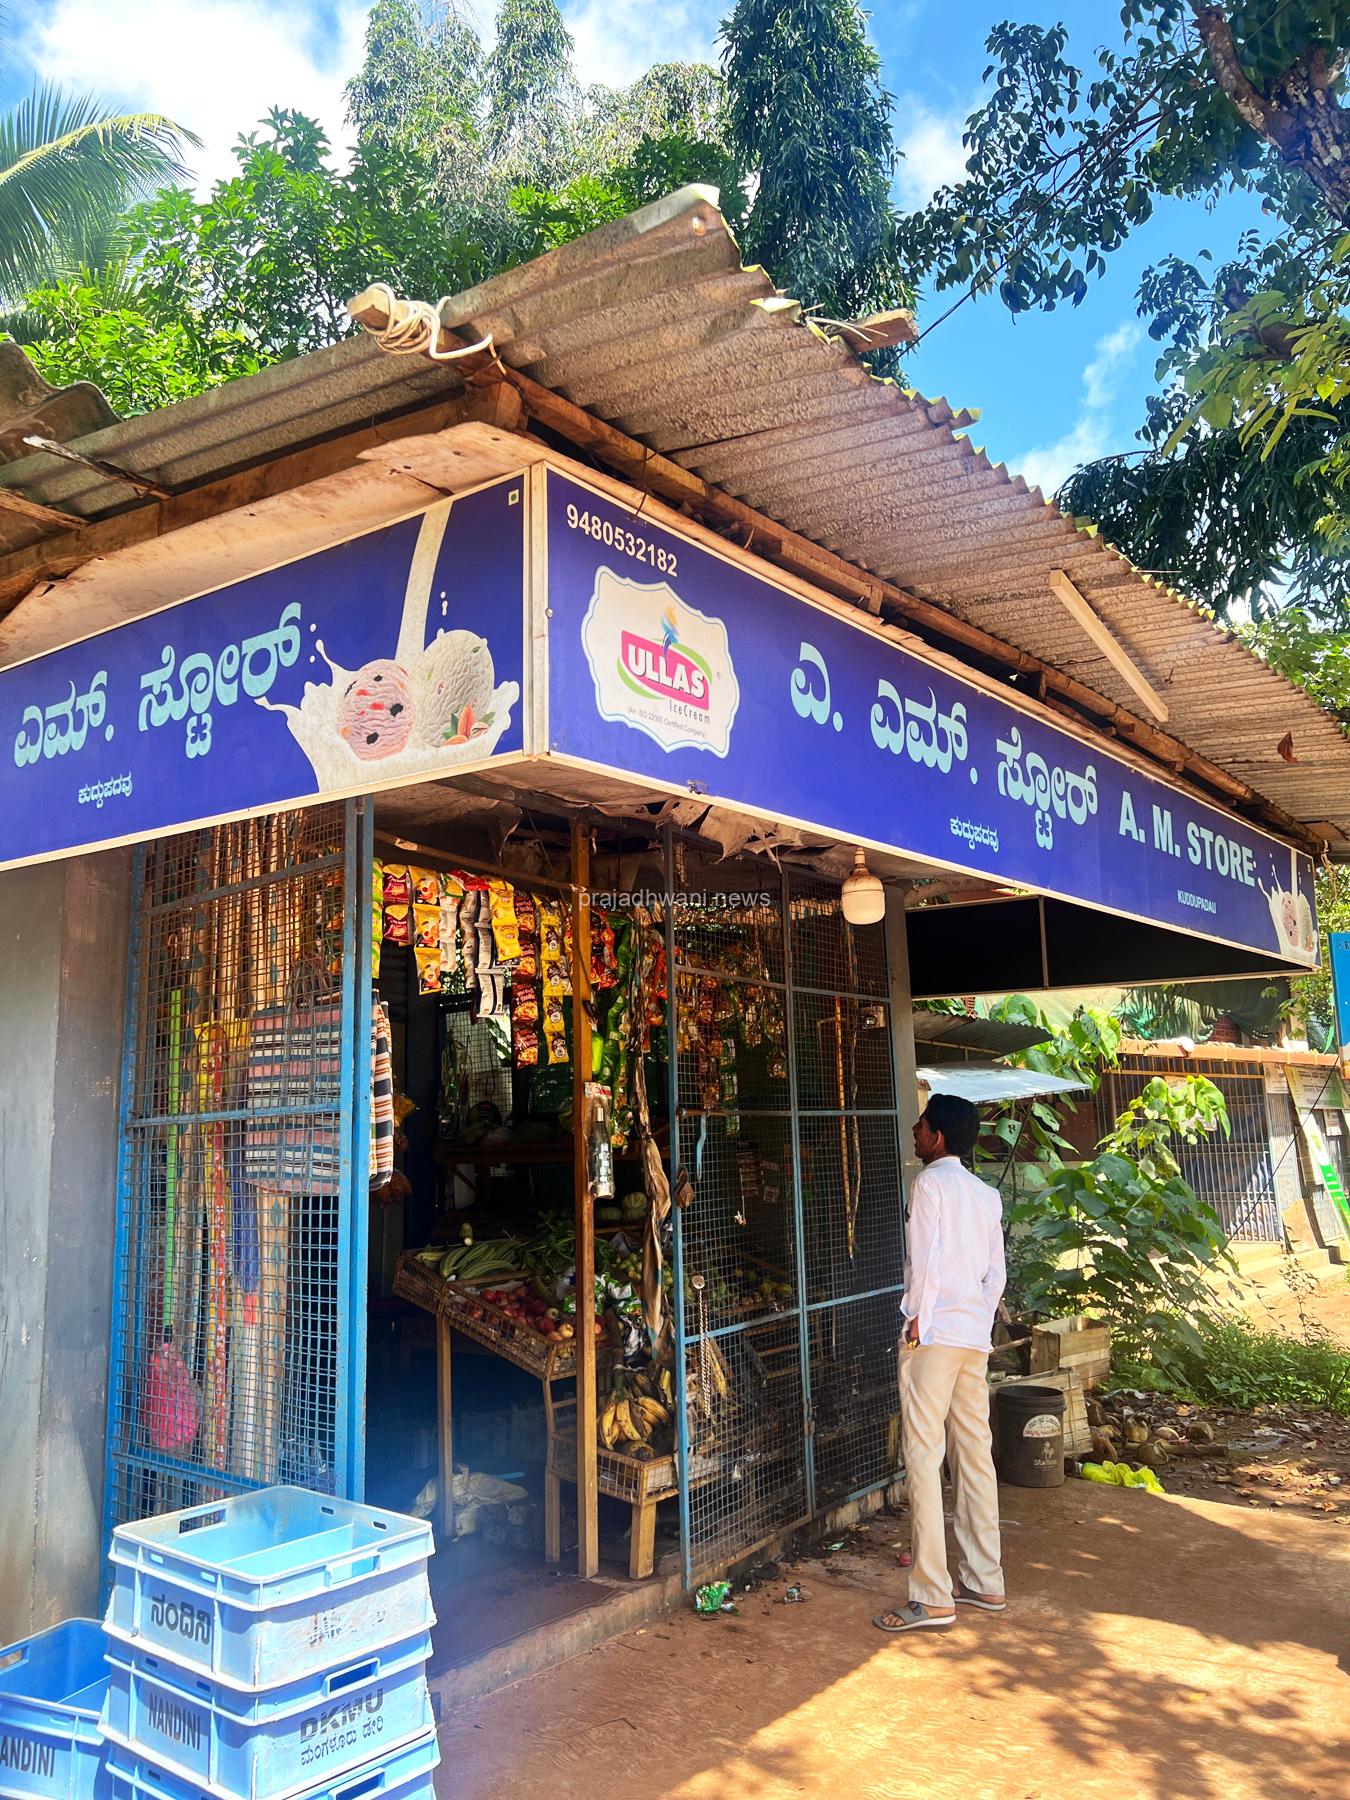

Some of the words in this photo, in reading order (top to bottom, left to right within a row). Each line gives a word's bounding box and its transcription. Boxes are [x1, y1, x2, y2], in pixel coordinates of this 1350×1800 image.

[567, 504, 678, 577] 9480532182
[138, 602, 302, 759] ಸ್ಟೋರ್
[628, 643, 706, 699] ULLAS
[996, 726, 1098, 851] ಸ್ಟೋರ್
[1119, 791, 1145, 843] A.
[1152, 804, 1181, 857] M.
[1187, 822, 1255, 887] STORE
[151, 1594, 210, 1645] ನಂದಿನಿ
[149, 1692, 200, 1751] NANDINI
[300, 1688, 384, 1744] DKMU
